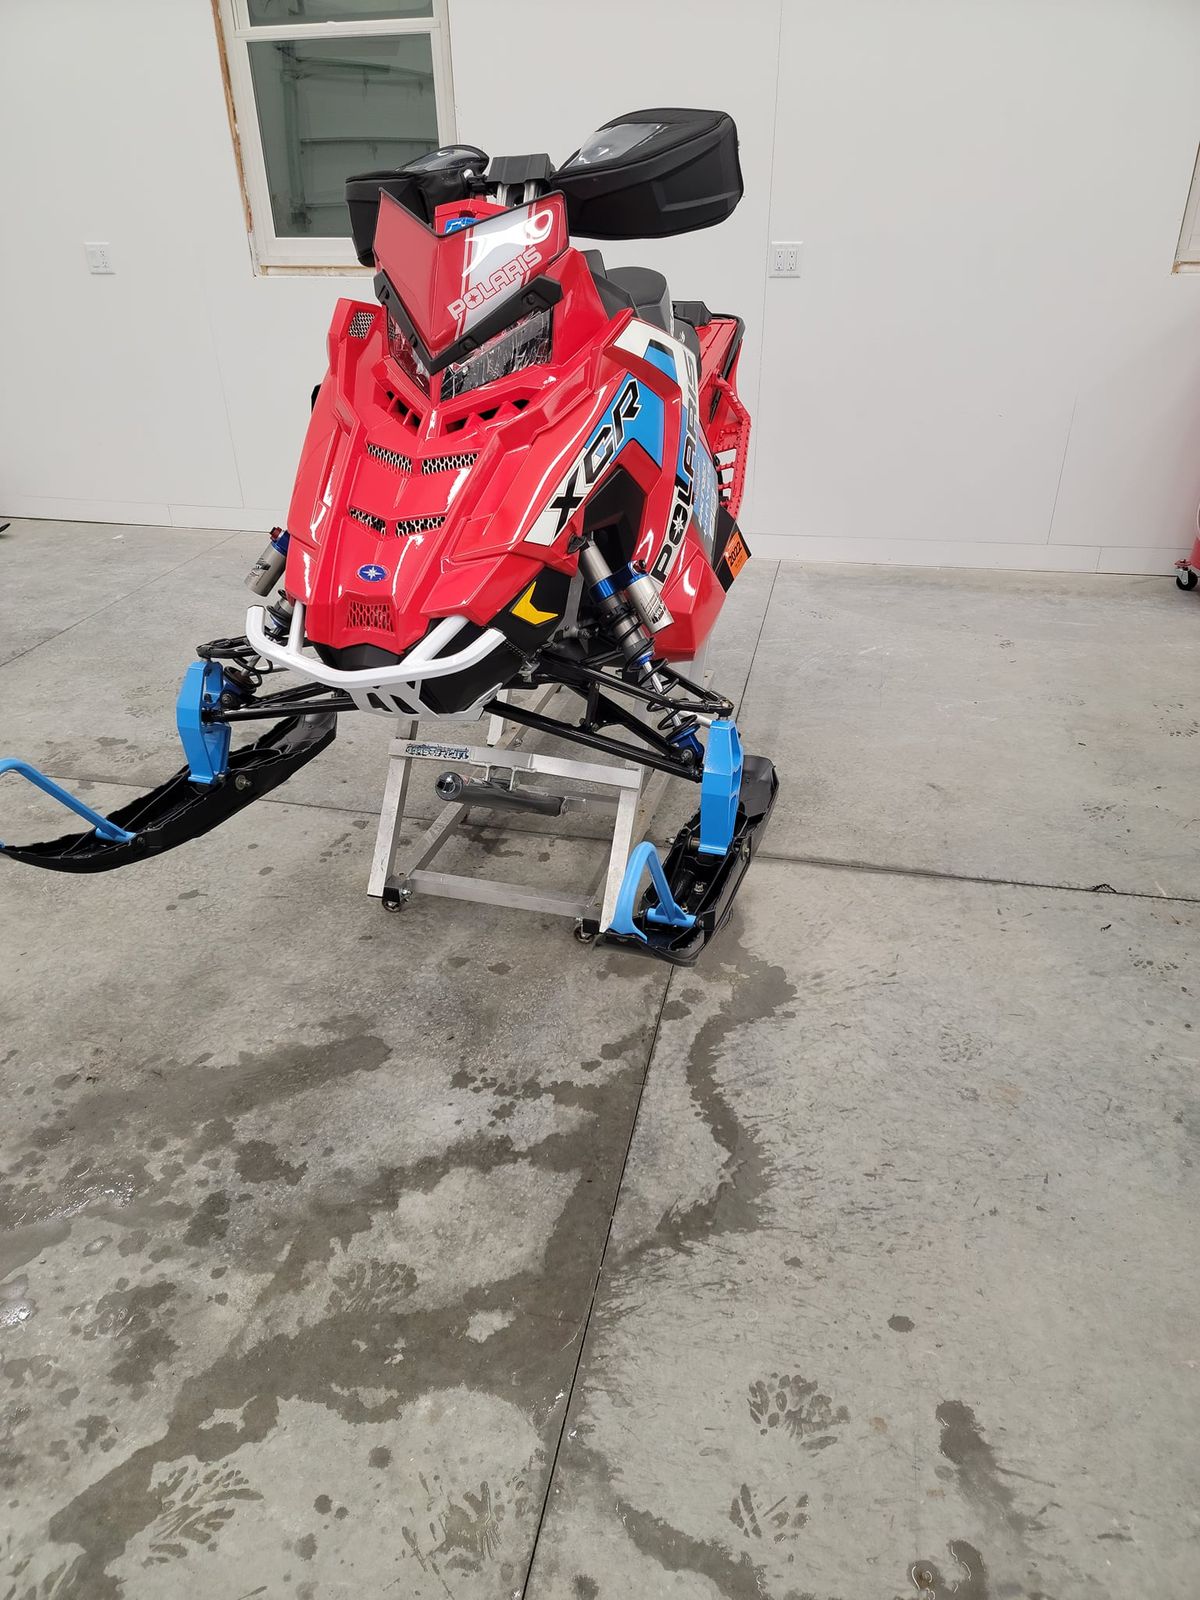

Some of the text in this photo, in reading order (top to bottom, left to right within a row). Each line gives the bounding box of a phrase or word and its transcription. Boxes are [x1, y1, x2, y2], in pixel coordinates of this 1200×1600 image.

[446, 246, 542, 320] POLARIS
[549, 377, 643, 539] XCR
[650, 350, 698, 582] POLARIS
[728, 541, 742, 567] 2022
